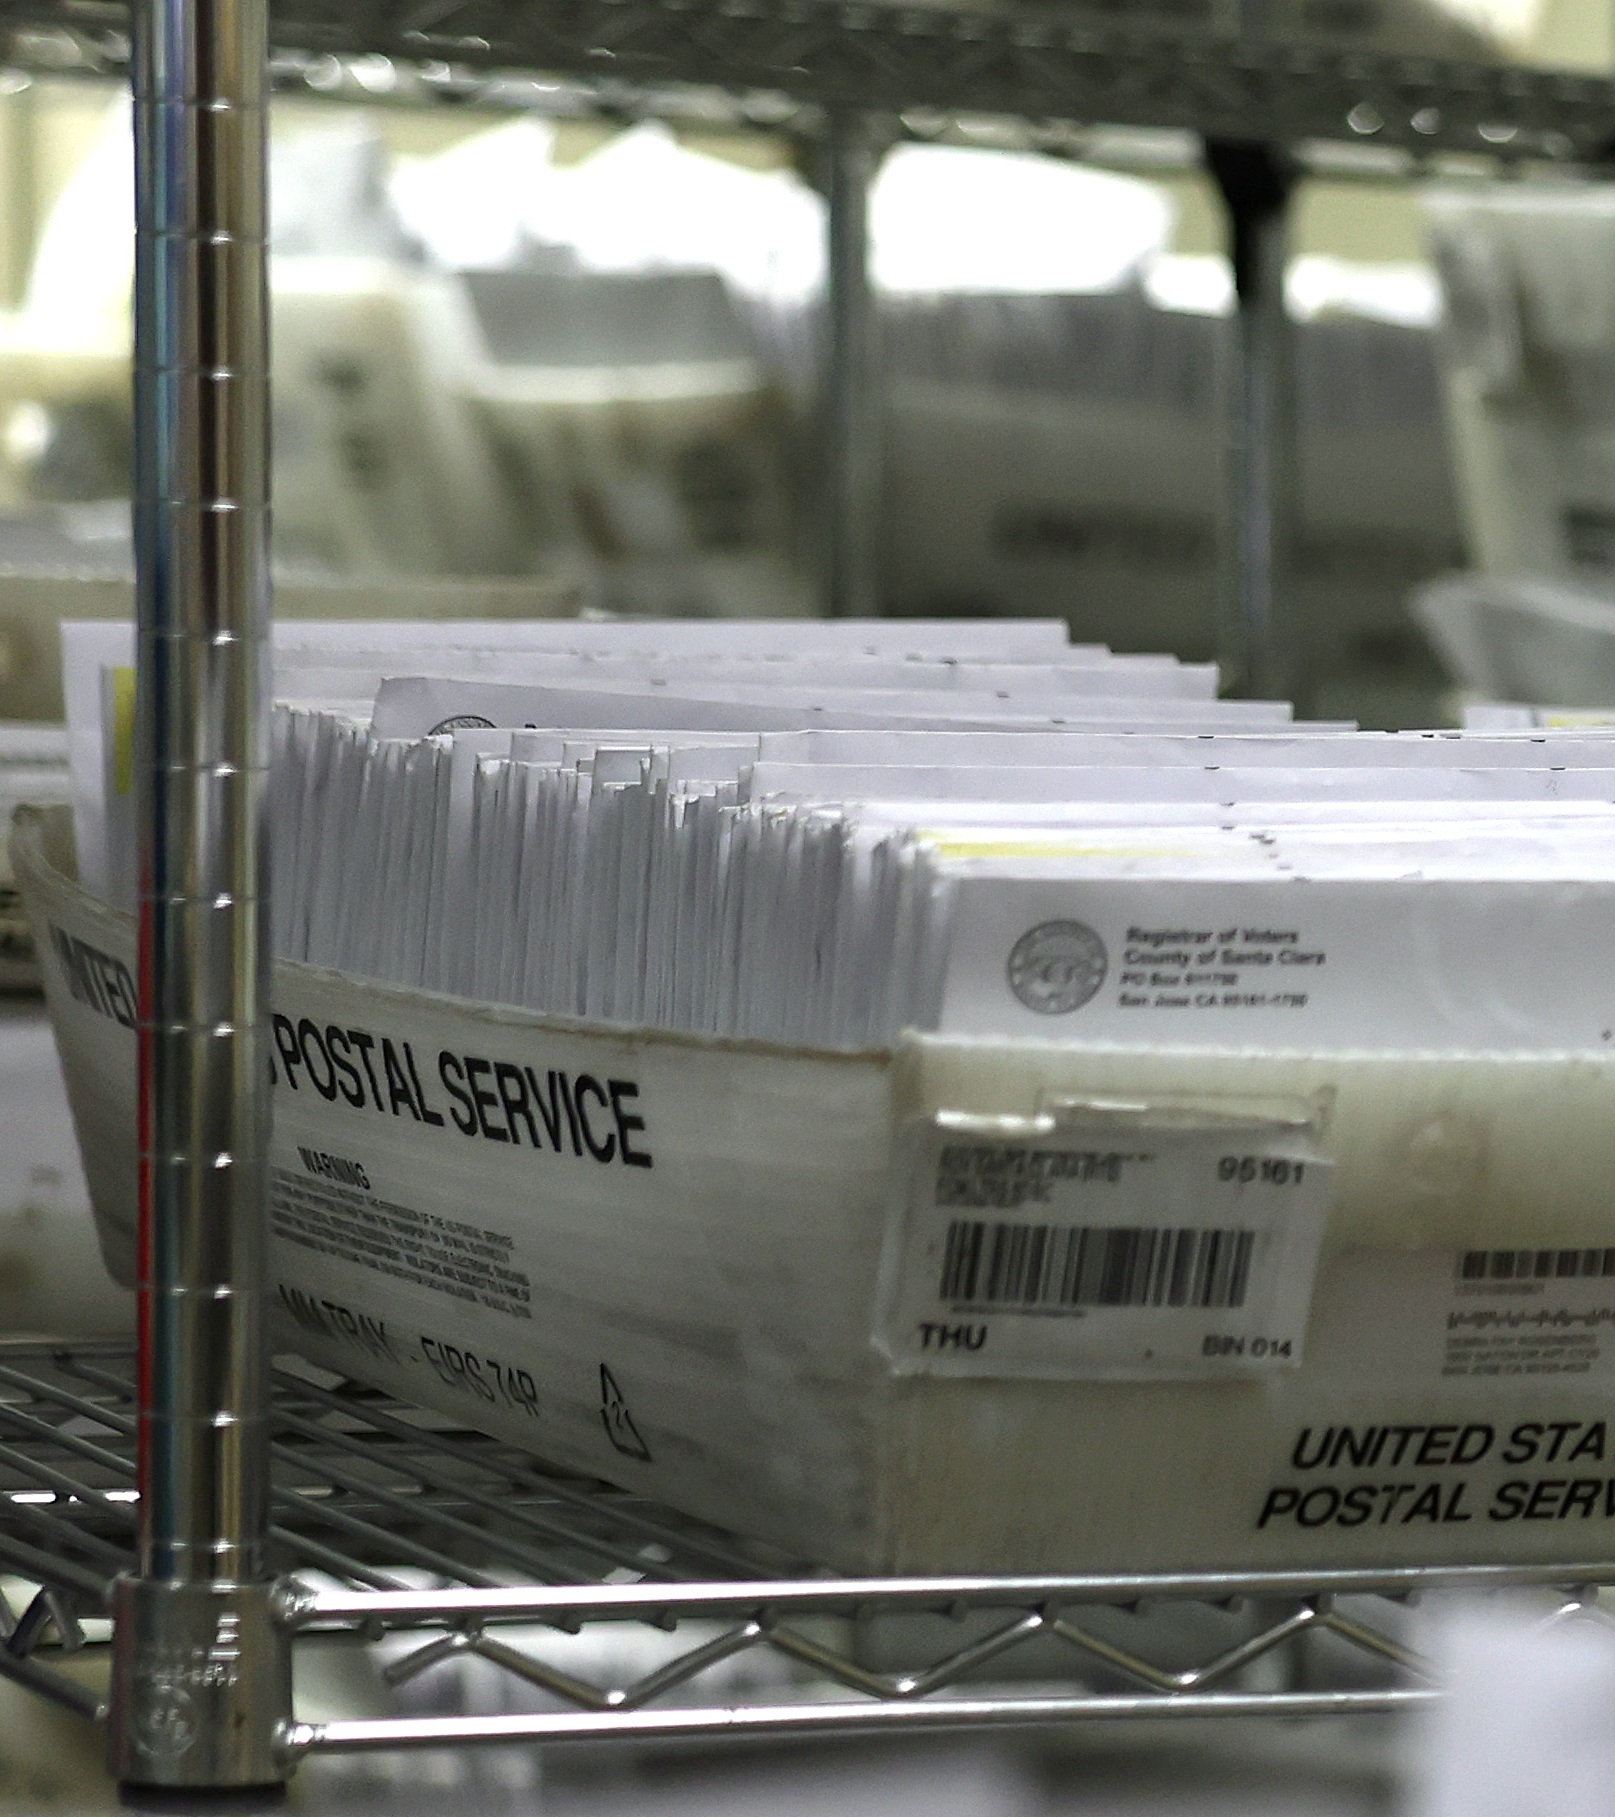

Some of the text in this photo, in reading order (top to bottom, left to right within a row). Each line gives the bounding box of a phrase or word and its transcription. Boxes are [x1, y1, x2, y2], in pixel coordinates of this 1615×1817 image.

[272, 1012, 654, 1169] POSTAL SERVICE
[297, 1146, 371, 1190] WARNING
[918, 1323, 1293, 1359] THU BIN 014
[421, 1336, 497, 1402] EIRS
[1291, 1422, 1494, 1469] UNITED
[1256, 1480, 1479, 1530] POSTAL
